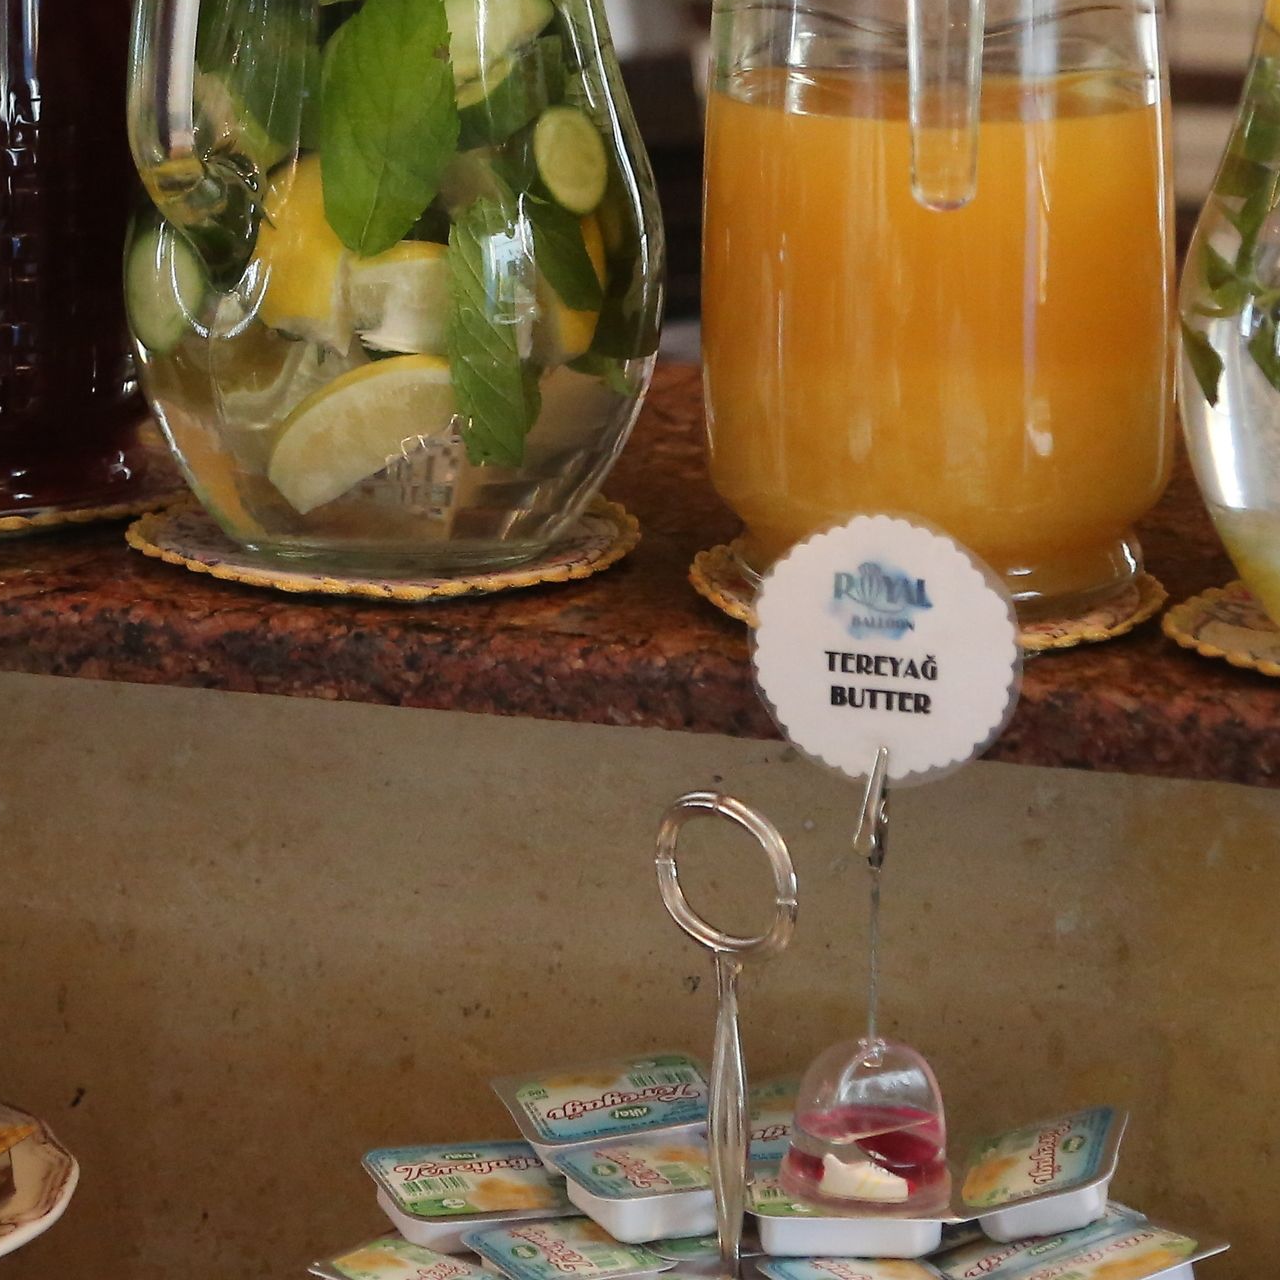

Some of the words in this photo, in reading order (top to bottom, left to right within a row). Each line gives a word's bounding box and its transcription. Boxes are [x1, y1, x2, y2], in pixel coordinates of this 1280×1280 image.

[832, 565, 934, 611] ROYAL
[851, 614, 915, 632] BALLOON
[824, 650, 939, 681] TEREYAĞ
[830, 684, 933, 716] BUTTER
